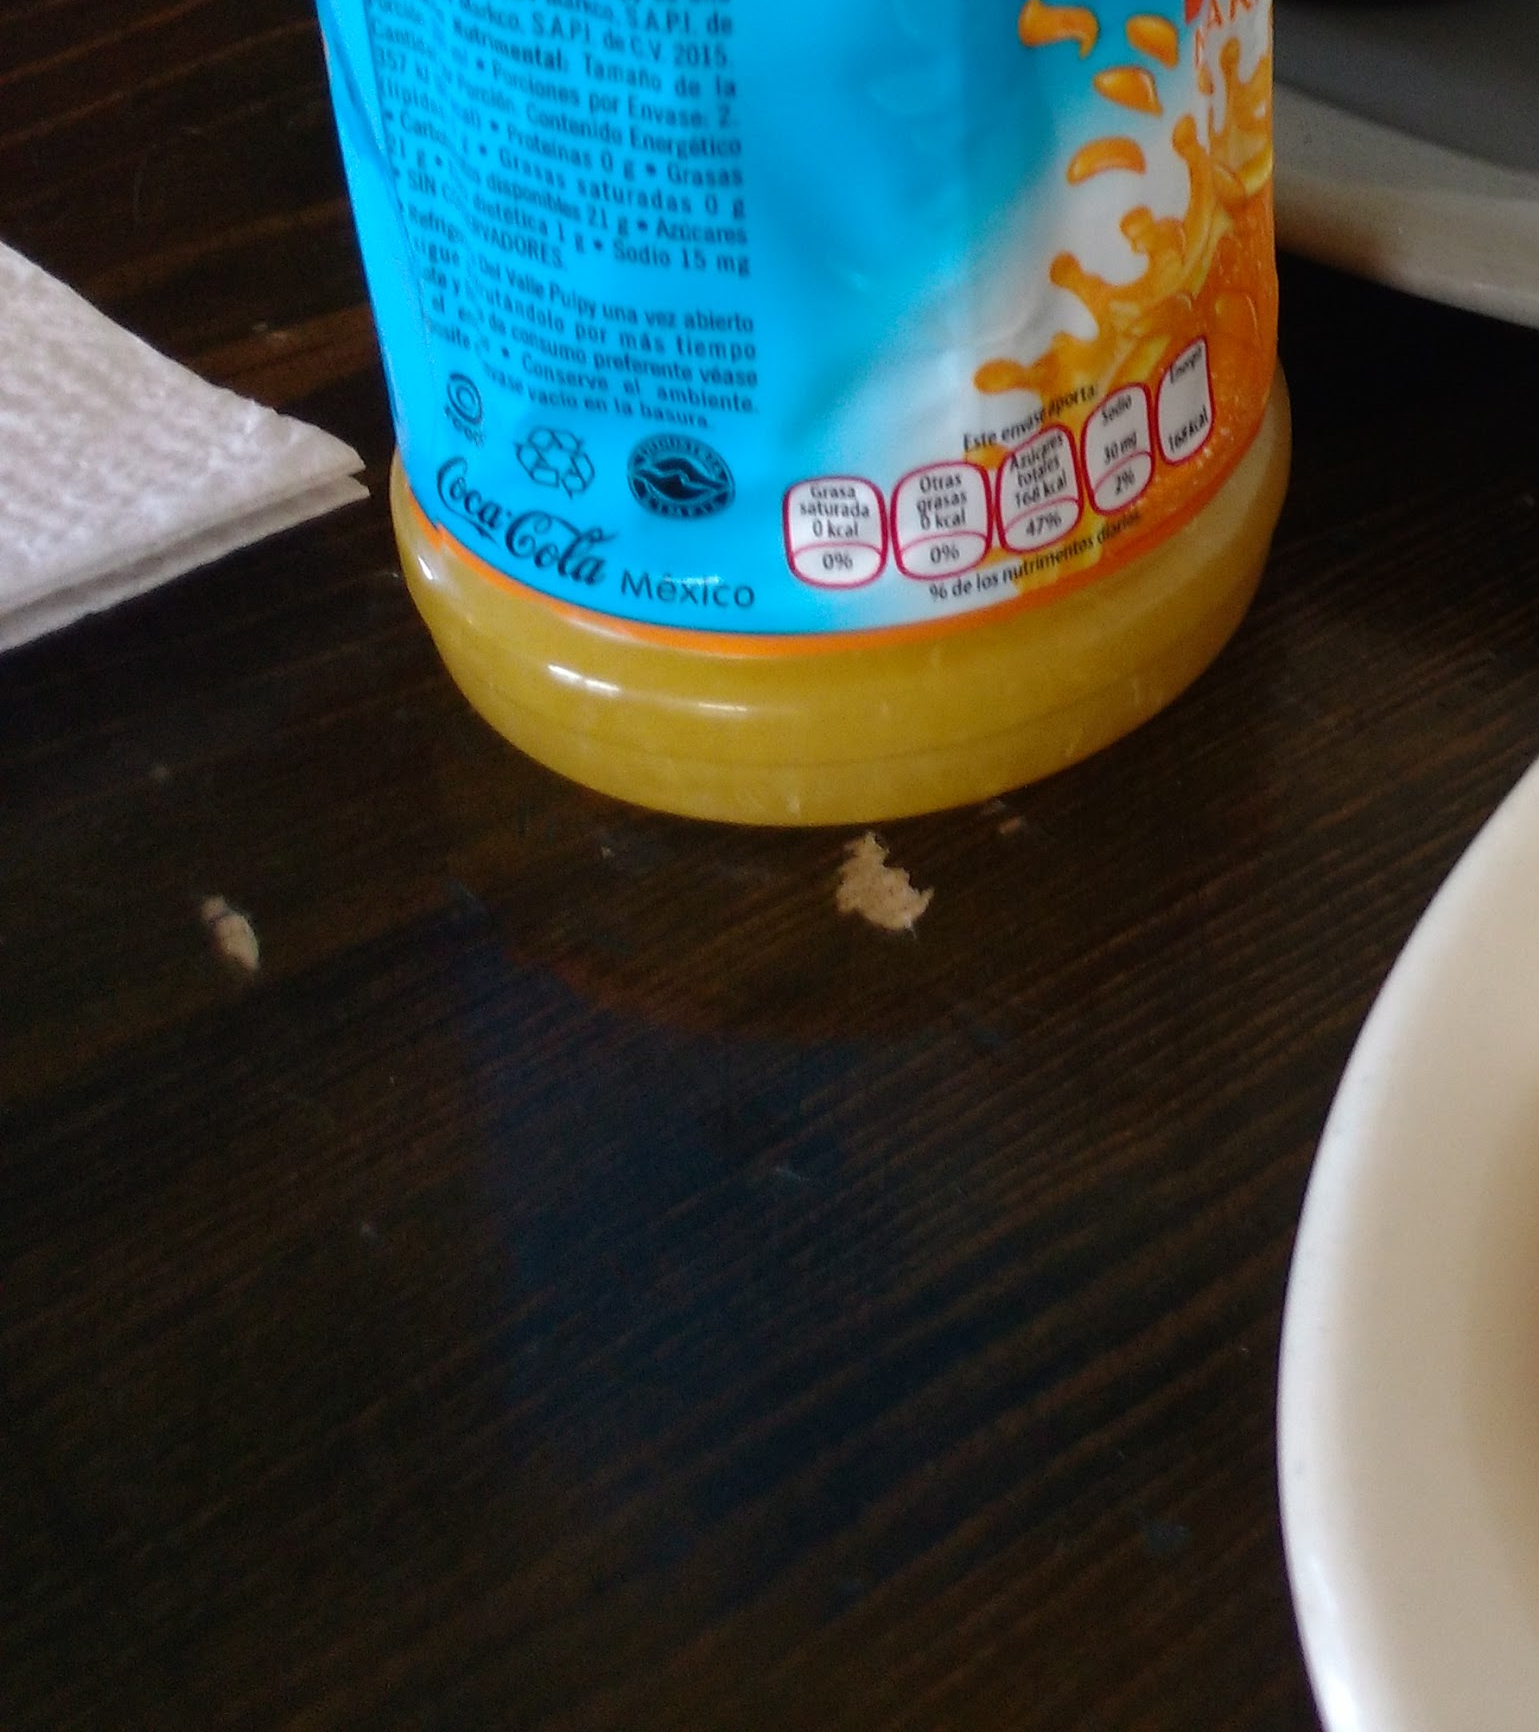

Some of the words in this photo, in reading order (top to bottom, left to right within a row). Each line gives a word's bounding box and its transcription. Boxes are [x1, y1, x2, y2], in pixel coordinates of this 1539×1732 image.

[706, 10, 734, 36] de
[602, 30, 626, 53] de
[491, 59, 580, 108] Porciones
[588, 91, 620, 117] por
[584, 52, 662, 94] Tamaño
[674, 76, 701, 98] de
[715, 74, 738, 98] la
[525, 101, 623, 146] Contenido
[629, 125, 742, 161] Energético
[506, 122, 594, 169] Proteínas
[600, 148, 615, 173] 0
[623, 159, 635, 182] g
[667, 161, 744, 187] Grasas
[575, 179, 693, 214] saturadas
[703, 191, 718, 216] 0
[732, 197, 745, 222] g
[587, 200, 608, 230] 21
[617, 215, 629, 238] g
[656, 216, 748, 246] Azúcares
[573, 230, 586, 255] g
[613, 235, 671, 267] Sodio
[680, 244, 706, 270] 15
[715, 251, 752, 278] mg
[504, 266, 545, 300] Valle
[549, 281, 597, 318] Pulpy
[601, 301, 638, 324] una
[645, 308, 677, 329] vez
[684, 308, 755, 333] abierto
[511, 323, 587, 365] consumo
[593, 351, 694, 384] preferente
[699, 366, 758, 389] véase
[573, 320, 607, 346] por
[618, 328, 666, 354] más
[675, 334, 758, 365] tiempo
[521, 352, 609, 392] Conserve
[527, 386, 578, 410] vacío
[583, 398, 609, 415] en
[614, 398, 634, 417] la
[1101, 394, 1134, 428] Sodio
[962, 431, 998, 452] Este
[1000, 409, 1045, 444] envase
[1103, 440, 1120, 465] 30
[919, 473, 962, 494] Otras
[1017, 456, 1061, 488] totales
[1043, 471, 1068, 501] kcal
[800, 500, 870, 518] saturada
[809, 485, 857, 500] Grasa
[916, 490, 968, 518] grasas
[436, 455, 619, 586] Coca-Cola
[620, 570, 755, 608] México
[812, 521, 824, 538] 0
[827, 520, 859, 539] kcal
[920, 516, 931, 531] 0
[935, 510, 966, 529] kcal
[1025, 513, 1063, 537] 47%
[822, 553, 854, 570] 0%
[928, 582, 949, 600] %
[952, 577, 974, 596] de
[977, 570, 1000, 592] los
[1002, 532, 1096, 585] nutrimentos
[929, 545, 960, 565] 0%
